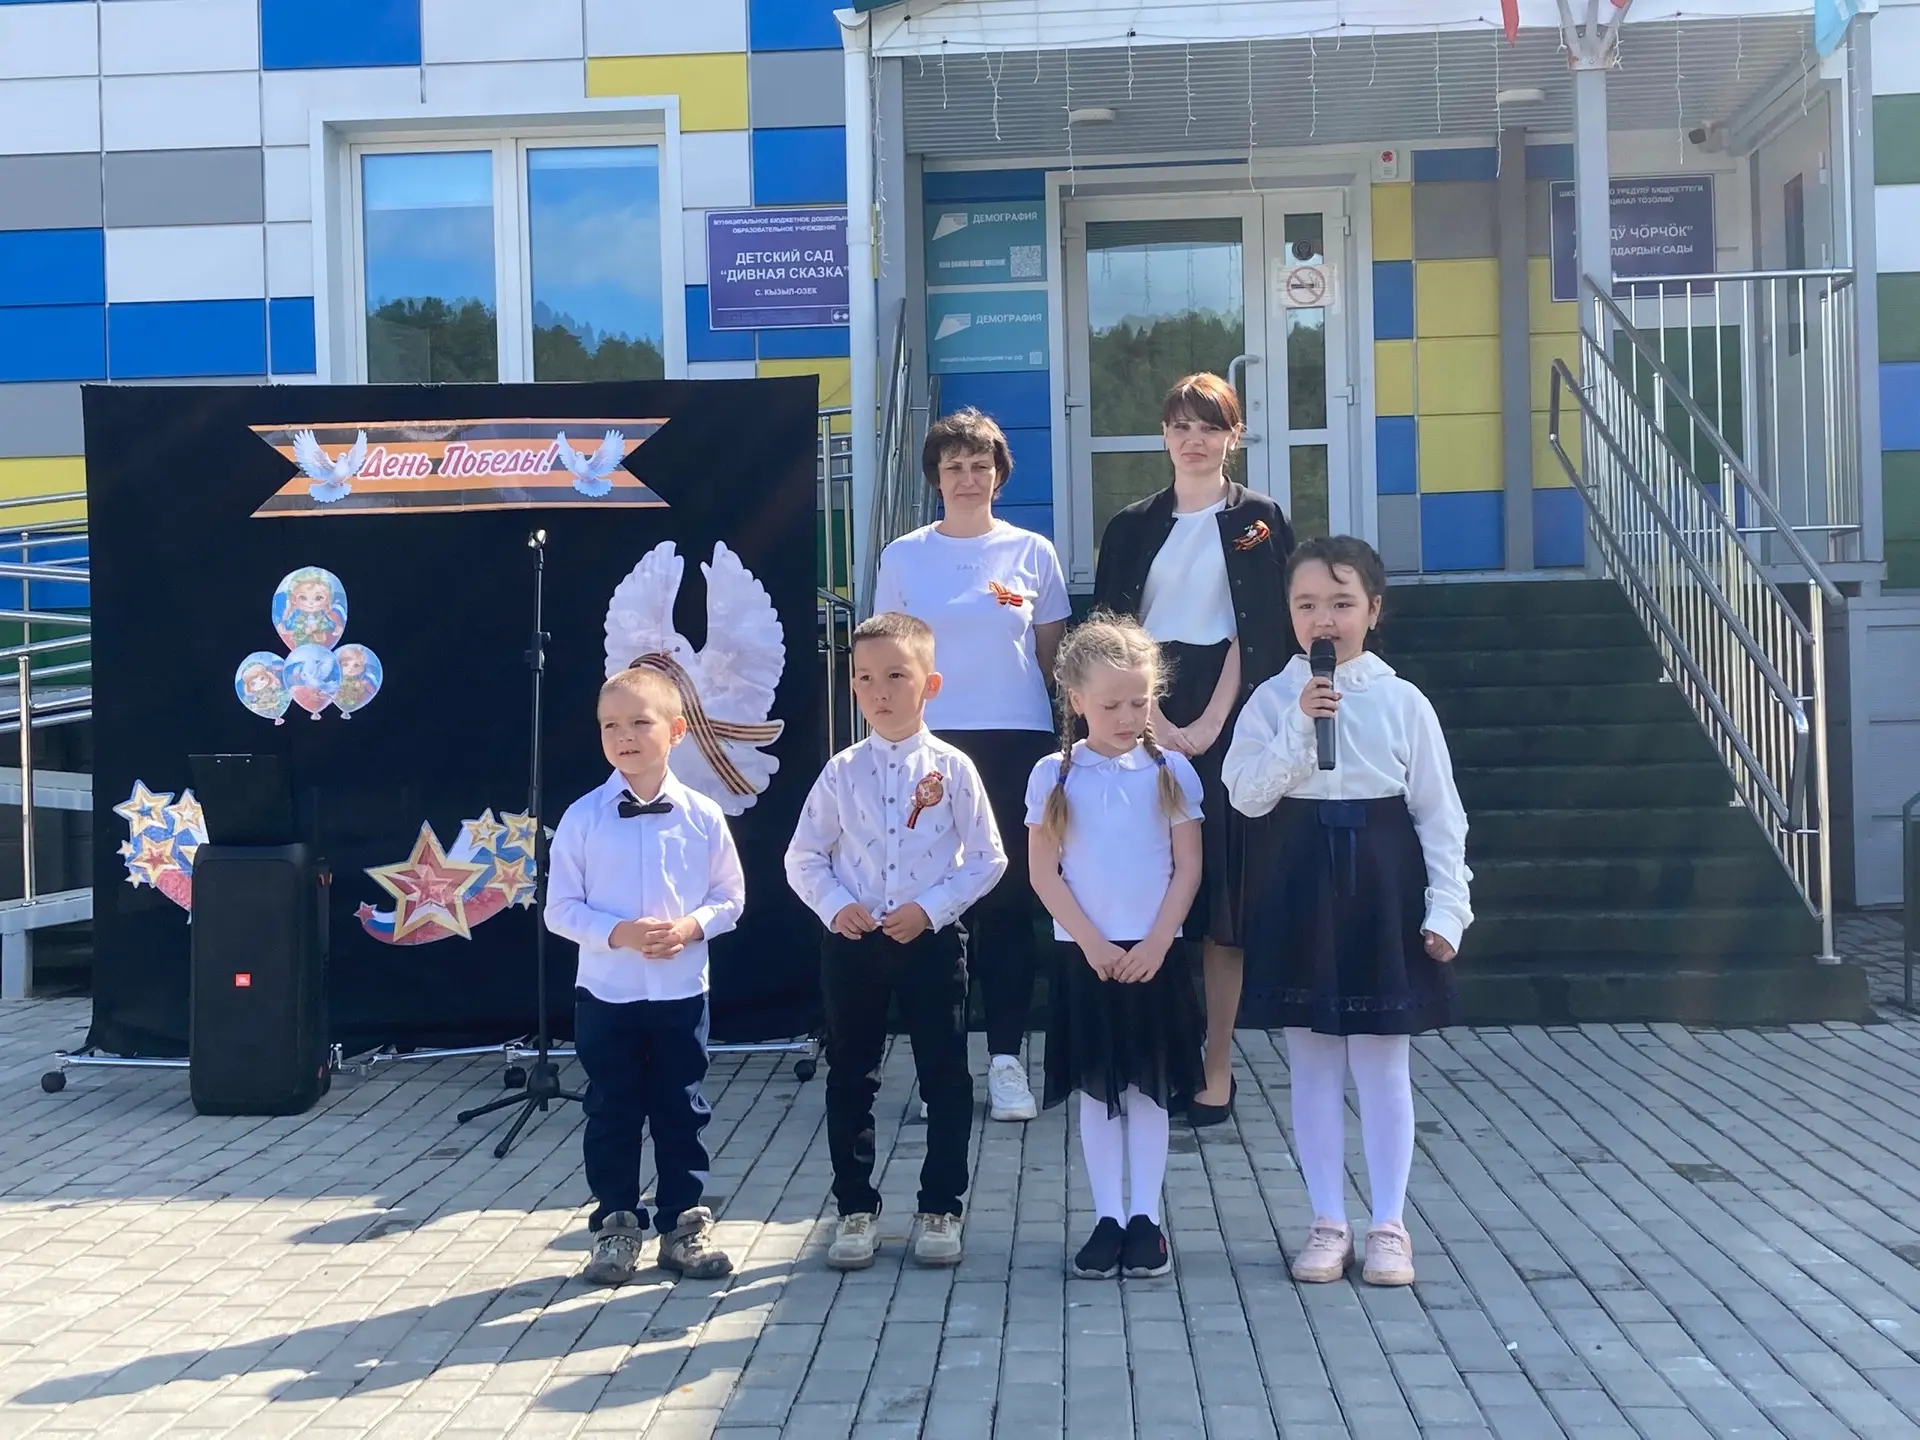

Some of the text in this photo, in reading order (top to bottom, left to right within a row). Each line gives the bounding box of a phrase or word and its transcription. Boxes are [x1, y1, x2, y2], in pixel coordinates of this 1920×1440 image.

[713, 215, 848, 226] МУНИЦИПАЛЬНОЕ БЮДЖЕТНОЕ ДОШКОЛЬН
[972, 212, 1038, 224] ДЕМОГРАФИЯ
[732, 224, 837, 234] ОБРАЗОВАТЕЛЬНОЕ УЧРЕЖДЕНИЕ
[1662, 244, 1694, 256] САДЫ
[735, 249, 834, 266] ДЕТСКИЙ САД
[764, 287, 818, 296] КЫЗЫЛ-ОЗЕК
[976, 313, 1042, 325] ДЕМОГРАФИЯ
[359, 443, 561, 479] День Победы!
